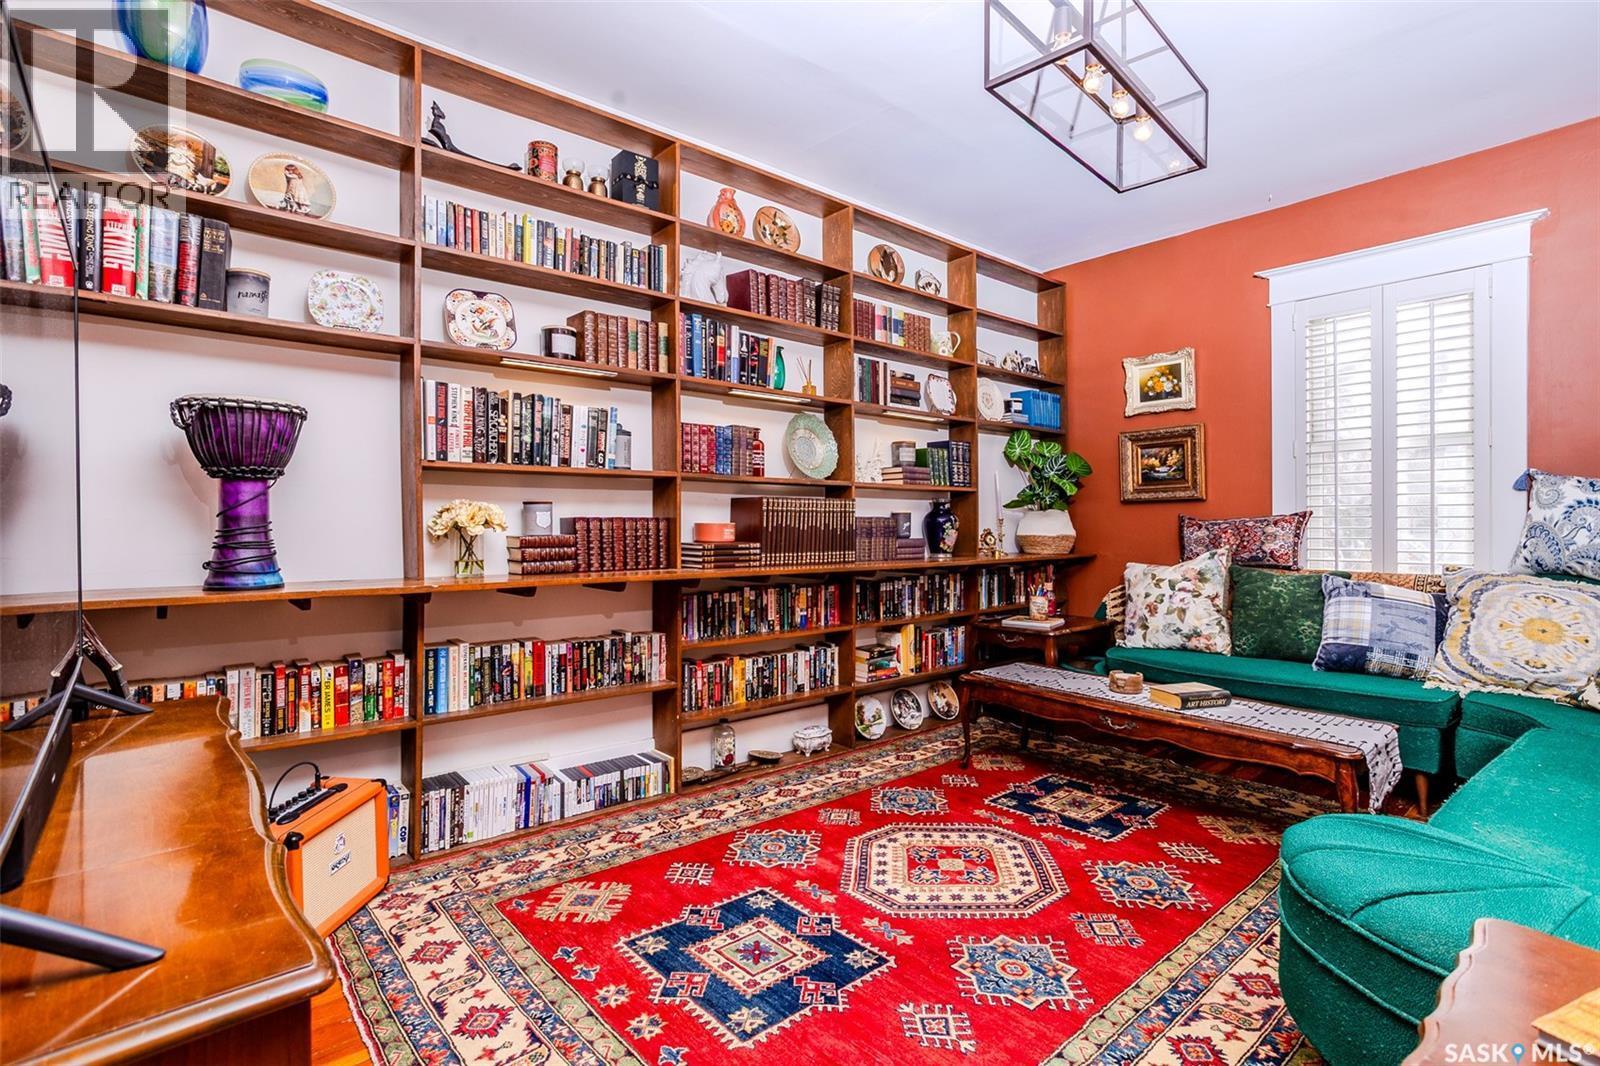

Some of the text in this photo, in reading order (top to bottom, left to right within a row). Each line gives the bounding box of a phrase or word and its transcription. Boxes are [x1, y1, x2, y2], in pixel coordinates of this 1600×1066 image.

[463, 400, 473, 422] PEOPLE
[463, 431, 473, 448] PERIL
[488, 409, 499, 455] SPYCATCHER
[1186, 698, 1227, 708] ART HISTORY
